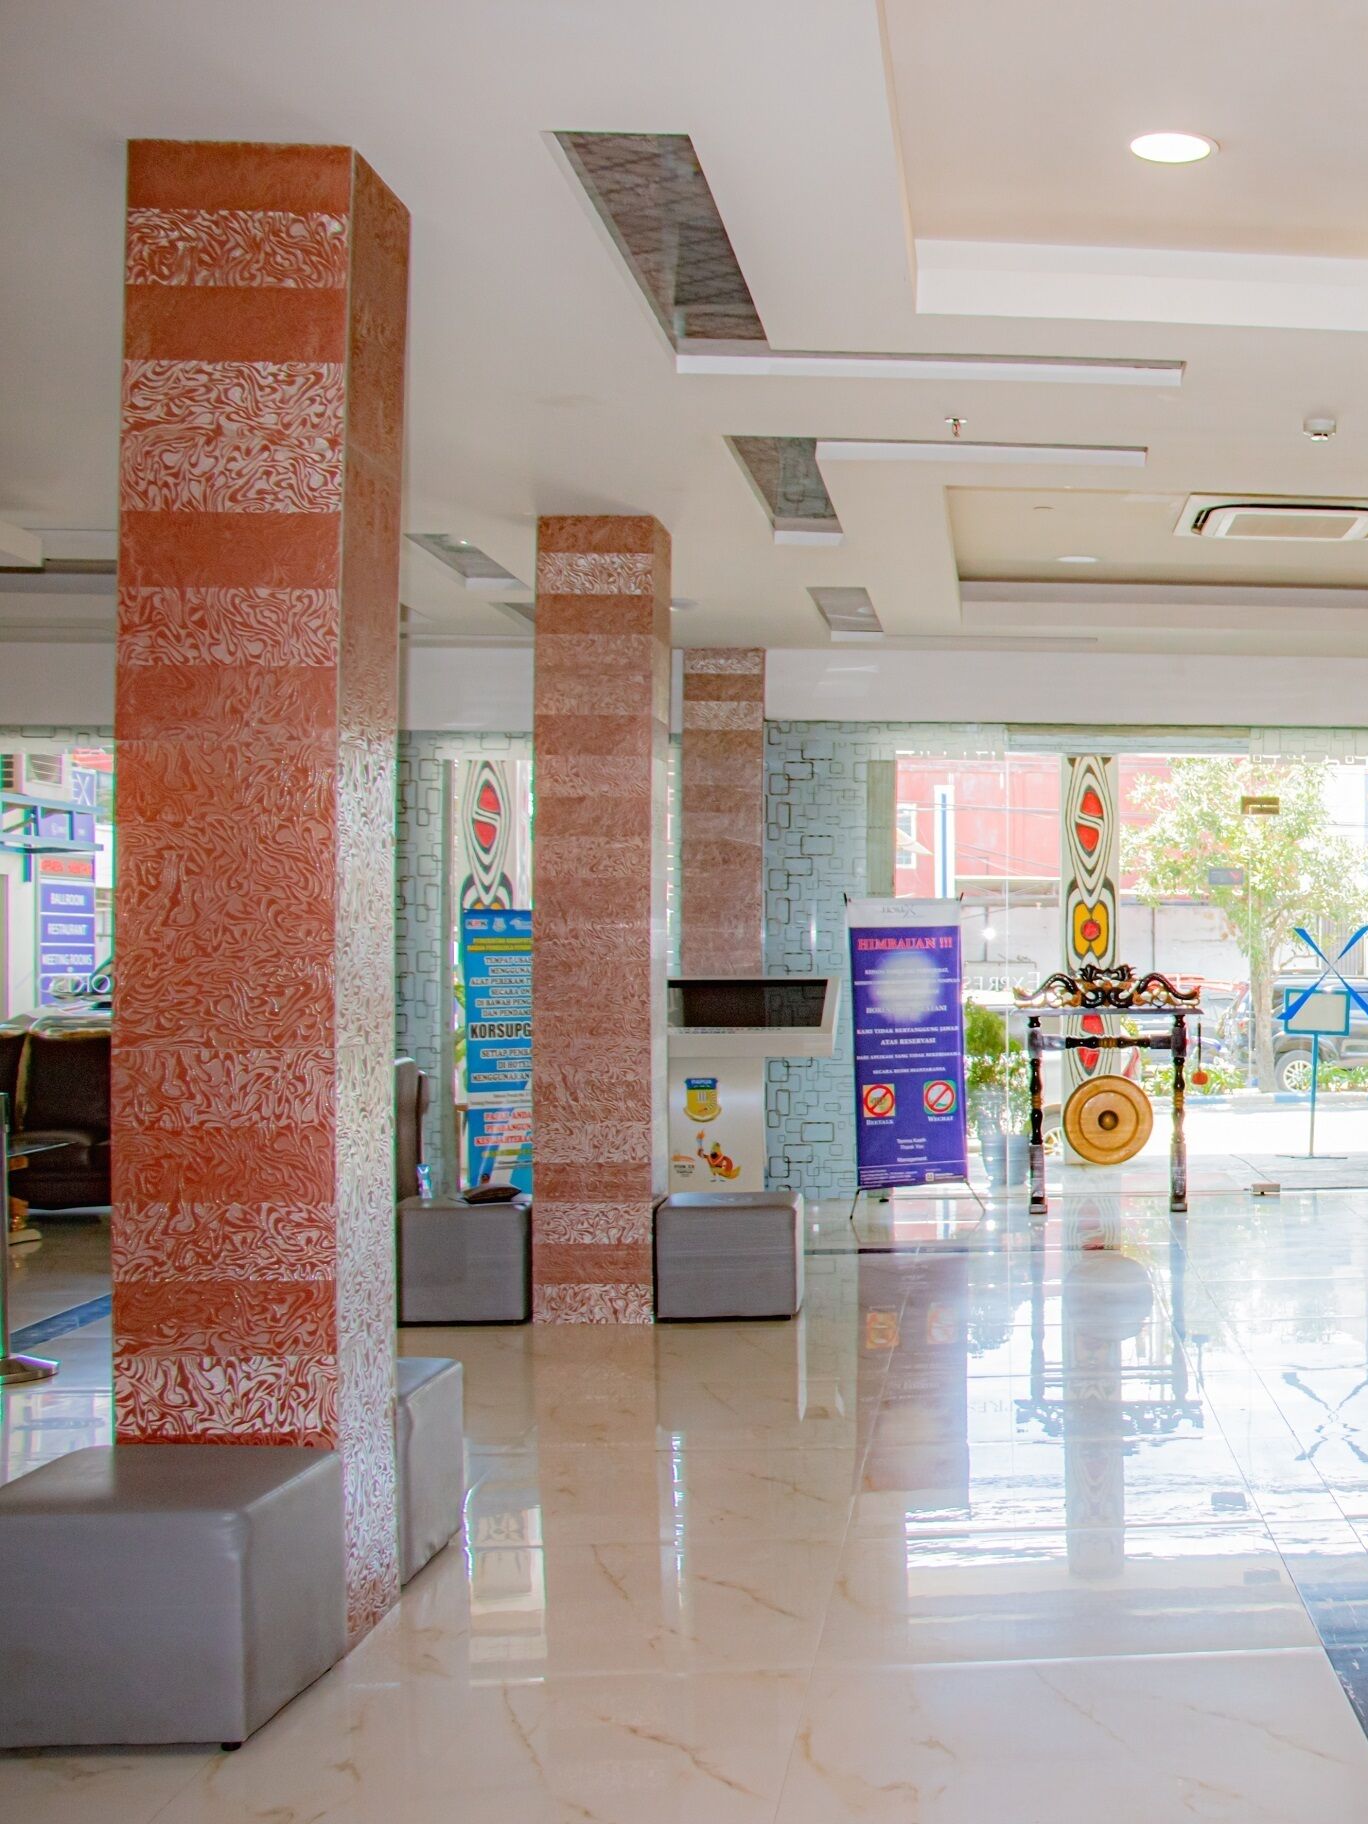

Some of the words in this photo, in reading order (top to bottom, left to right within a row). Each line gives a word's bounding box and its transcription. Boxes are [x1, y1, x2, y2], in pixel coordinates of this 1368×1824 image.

[50, 892, 86, 906] BALLROOM
[47, 922, 88, 936] RESTAURANT
[857, 938, 936, 951] HIMBAUAN
[940, 937, 953, 949] !!!
